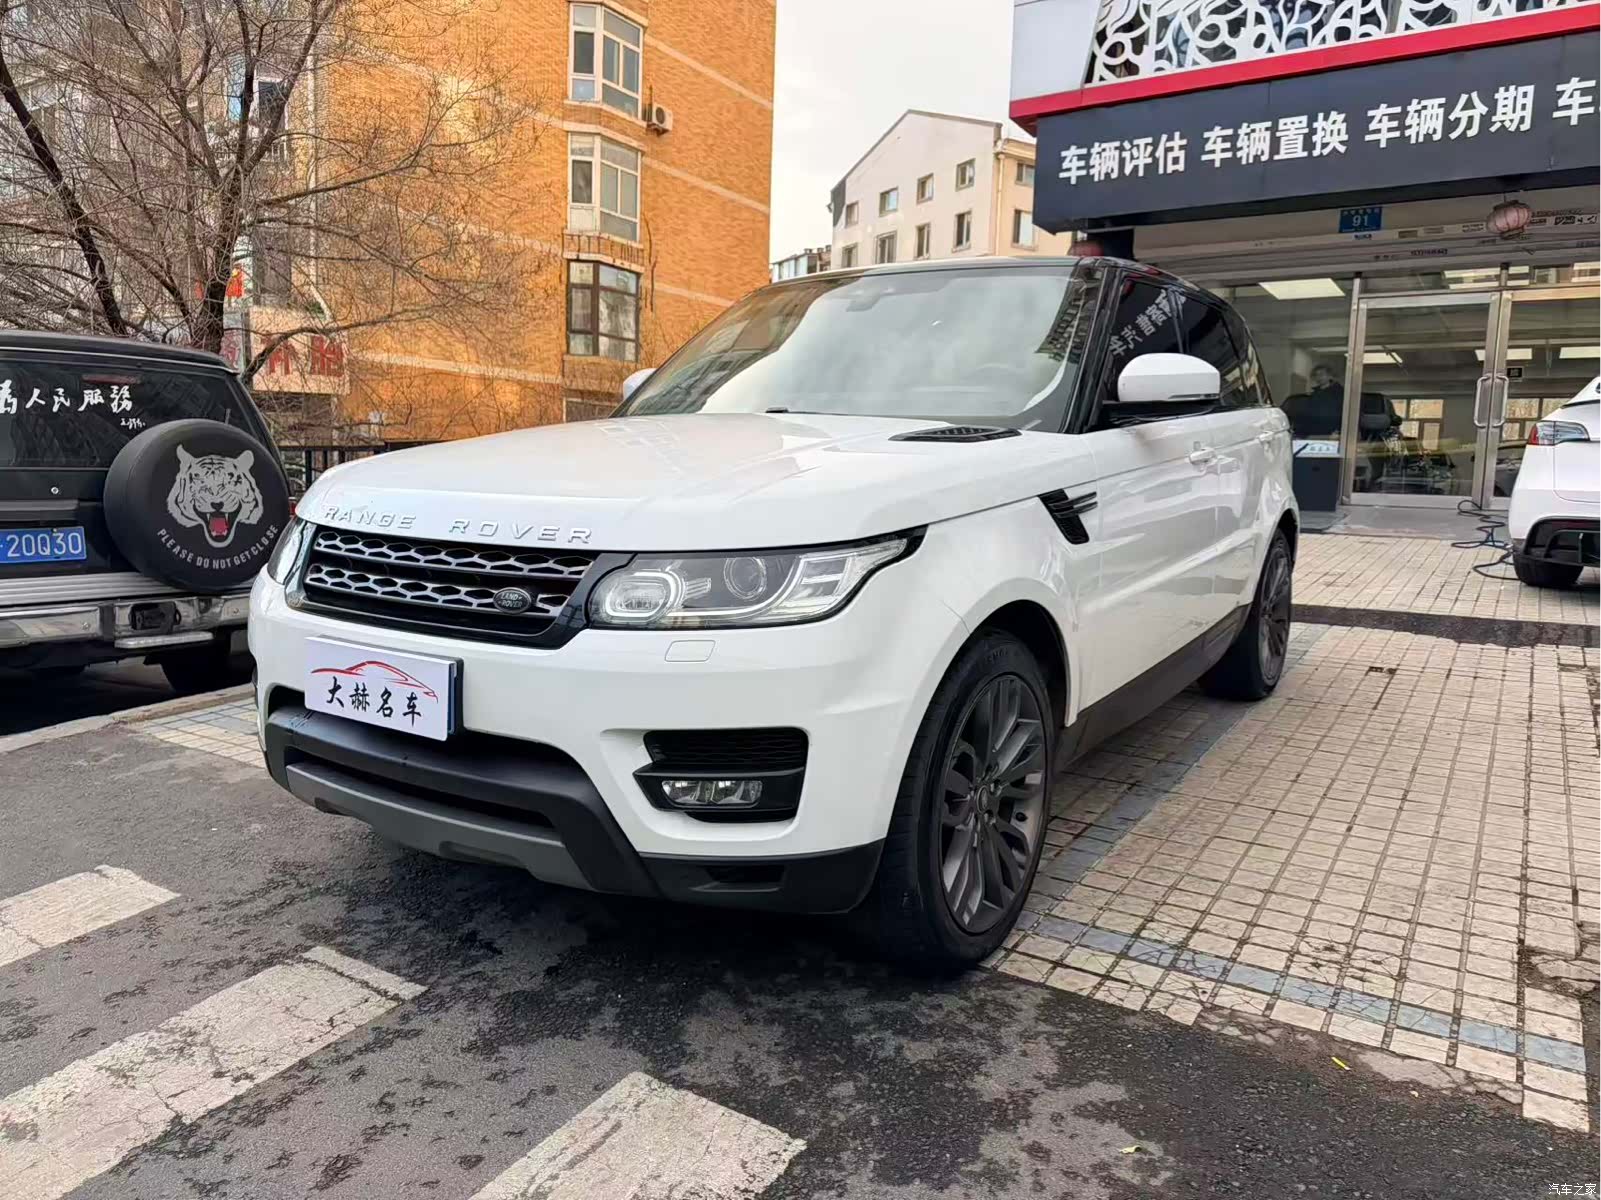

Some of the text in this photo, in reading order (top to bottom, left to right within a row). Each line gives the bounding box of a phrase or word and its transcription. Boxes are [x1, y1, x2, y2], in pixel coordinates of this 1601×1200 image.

[1058, 131, 1188, 185] 车辆评估
[1200, 110, 1349, 168] 车辆置换
[1364, 84, 1536, 148] 车辆分期
[1352, 214, 1369, 227] 91
[323, 504, 593, 545] RANGE ROVER
[157, 524, 279, 569] PLEASE DO NOT GET CLOSE
[501, 592, 519, 600] LAND
[502, 600, 523, 608] ROVER
[326, 676, 422, 728] 大赫名车
